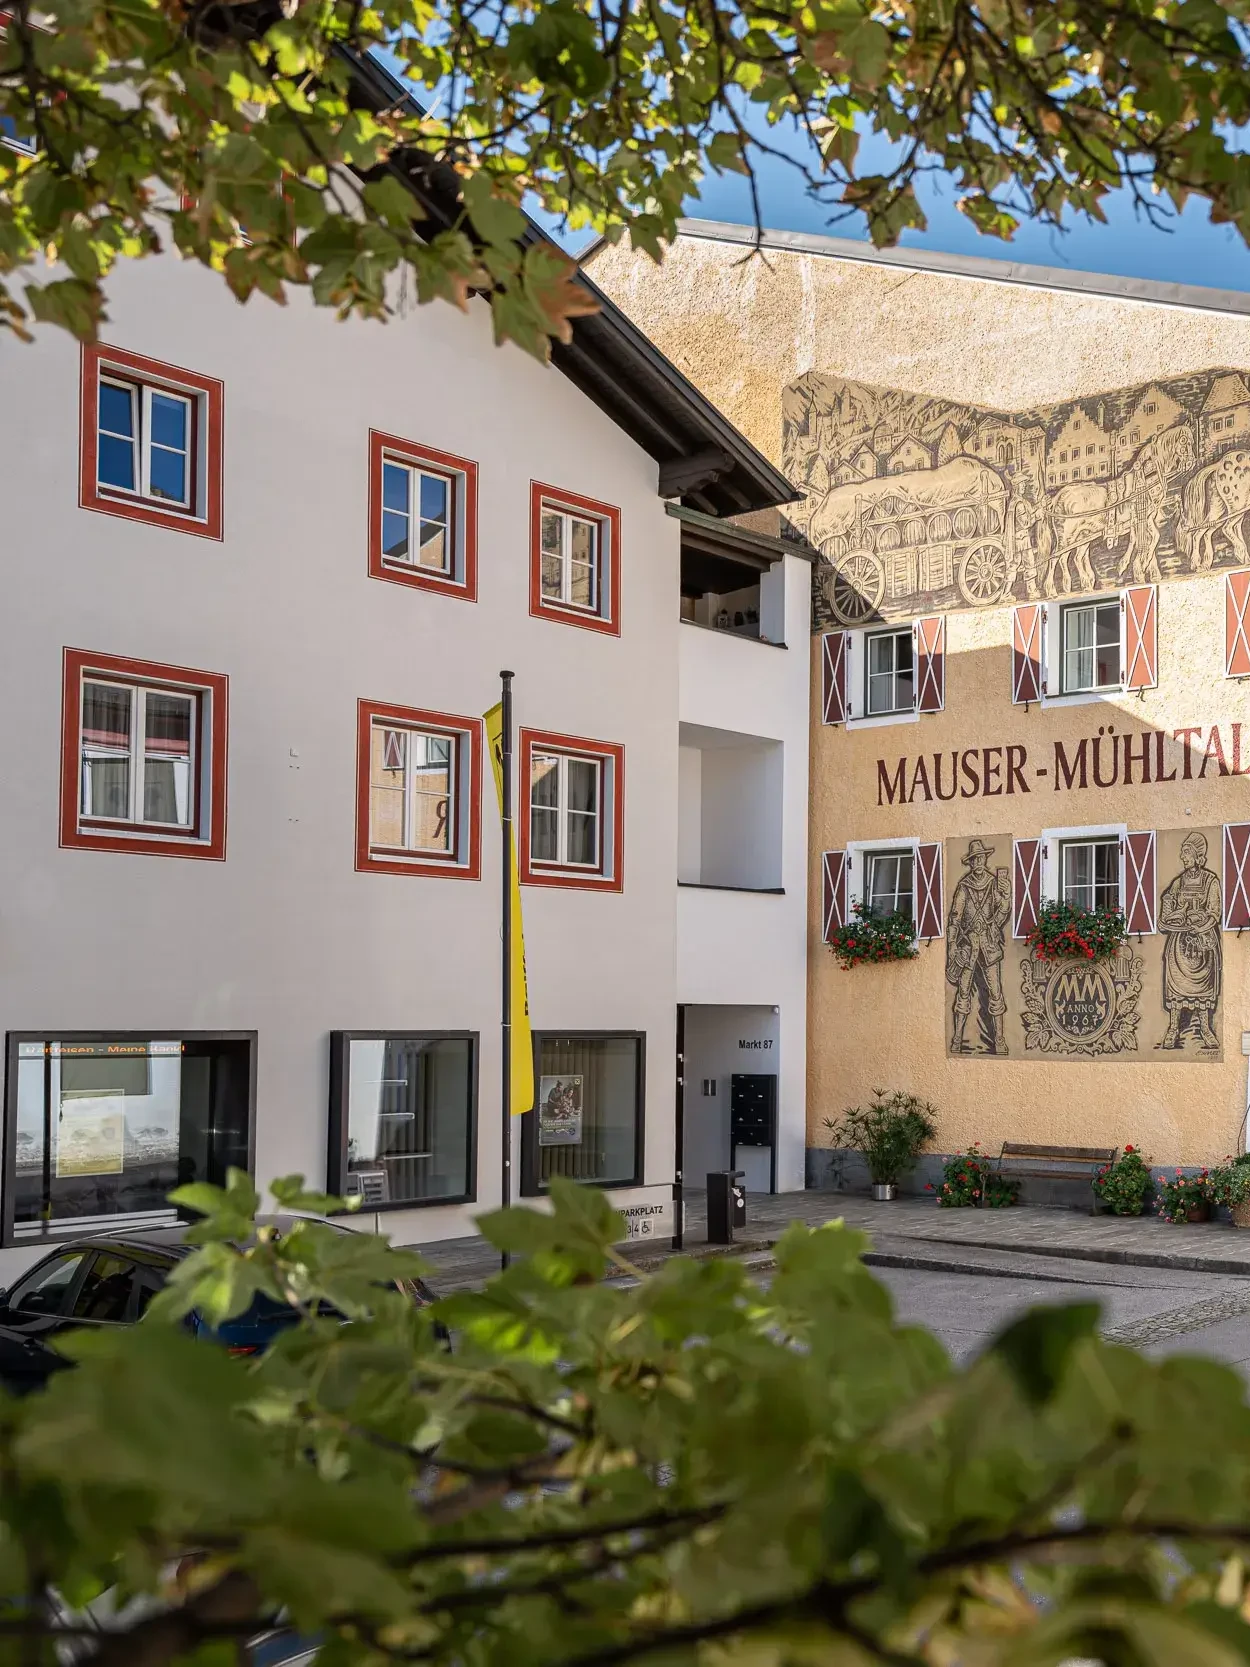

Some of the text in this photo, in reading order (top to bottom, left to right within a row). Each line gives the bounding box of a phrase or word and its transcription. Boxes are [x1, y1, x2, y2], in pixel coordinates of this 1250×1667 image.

[1054, 974, 1107, 1002] MM
[1067, 1004, 1095, 1013] ANNO
[1061, 1014, 1098, 1026] 1967
[738, 1040, 773, 1049] Markt 87
[615, 1205, 663, 1218] PARKPLATZ
